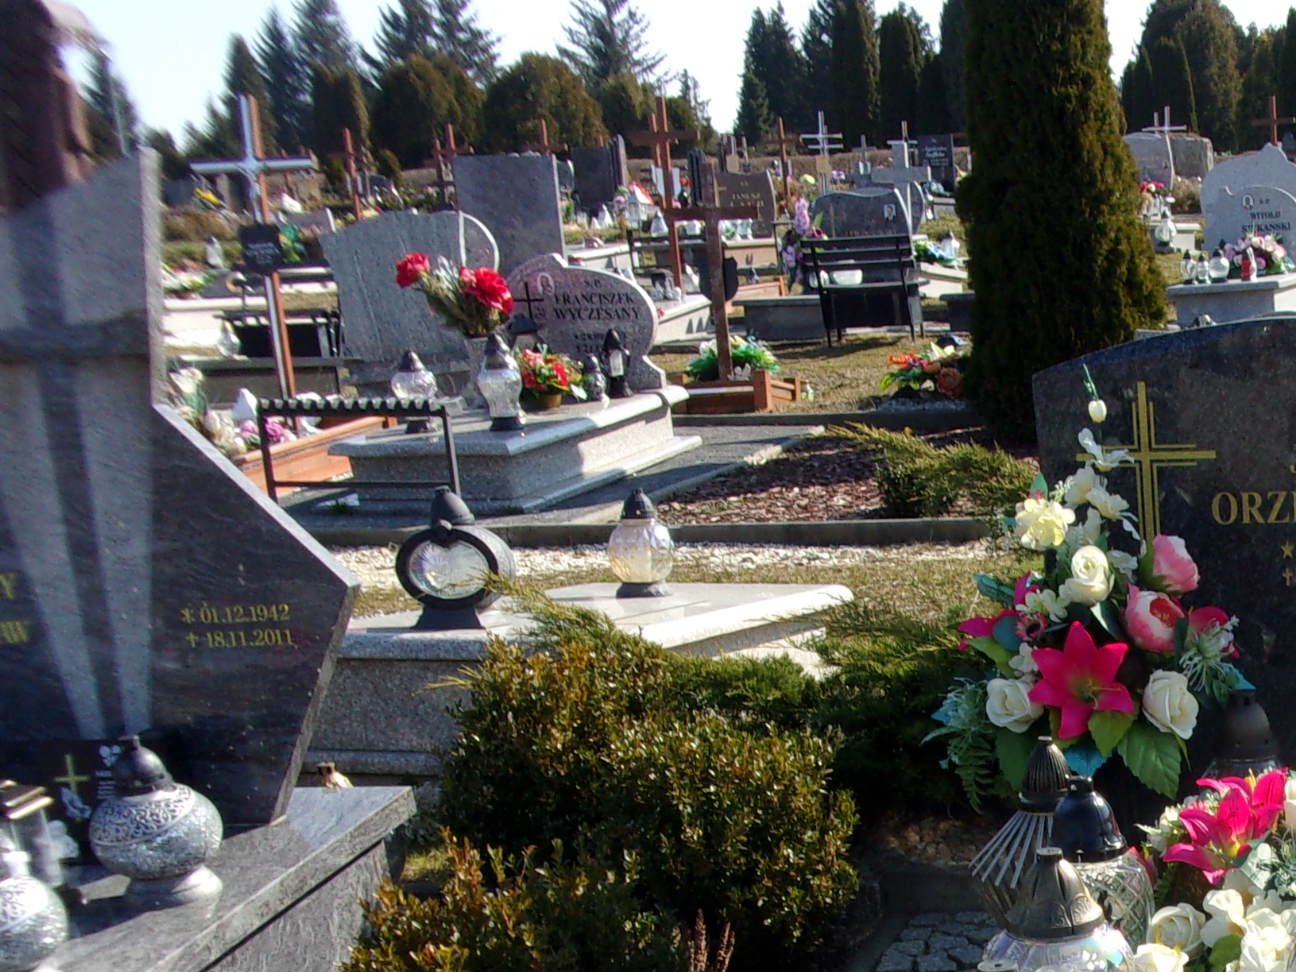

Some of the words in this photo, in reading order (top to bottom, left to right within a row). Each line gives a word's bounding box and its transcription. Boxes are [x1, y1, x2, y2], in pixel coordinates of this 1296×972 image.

[553, 292, 634, 305] FRANCISZEK
[552, 306, 640, 321] WYCZESANY
[200, 603, 291, 624] 01.12.1942
[206, 628, 293, 649] 18.11.2011
